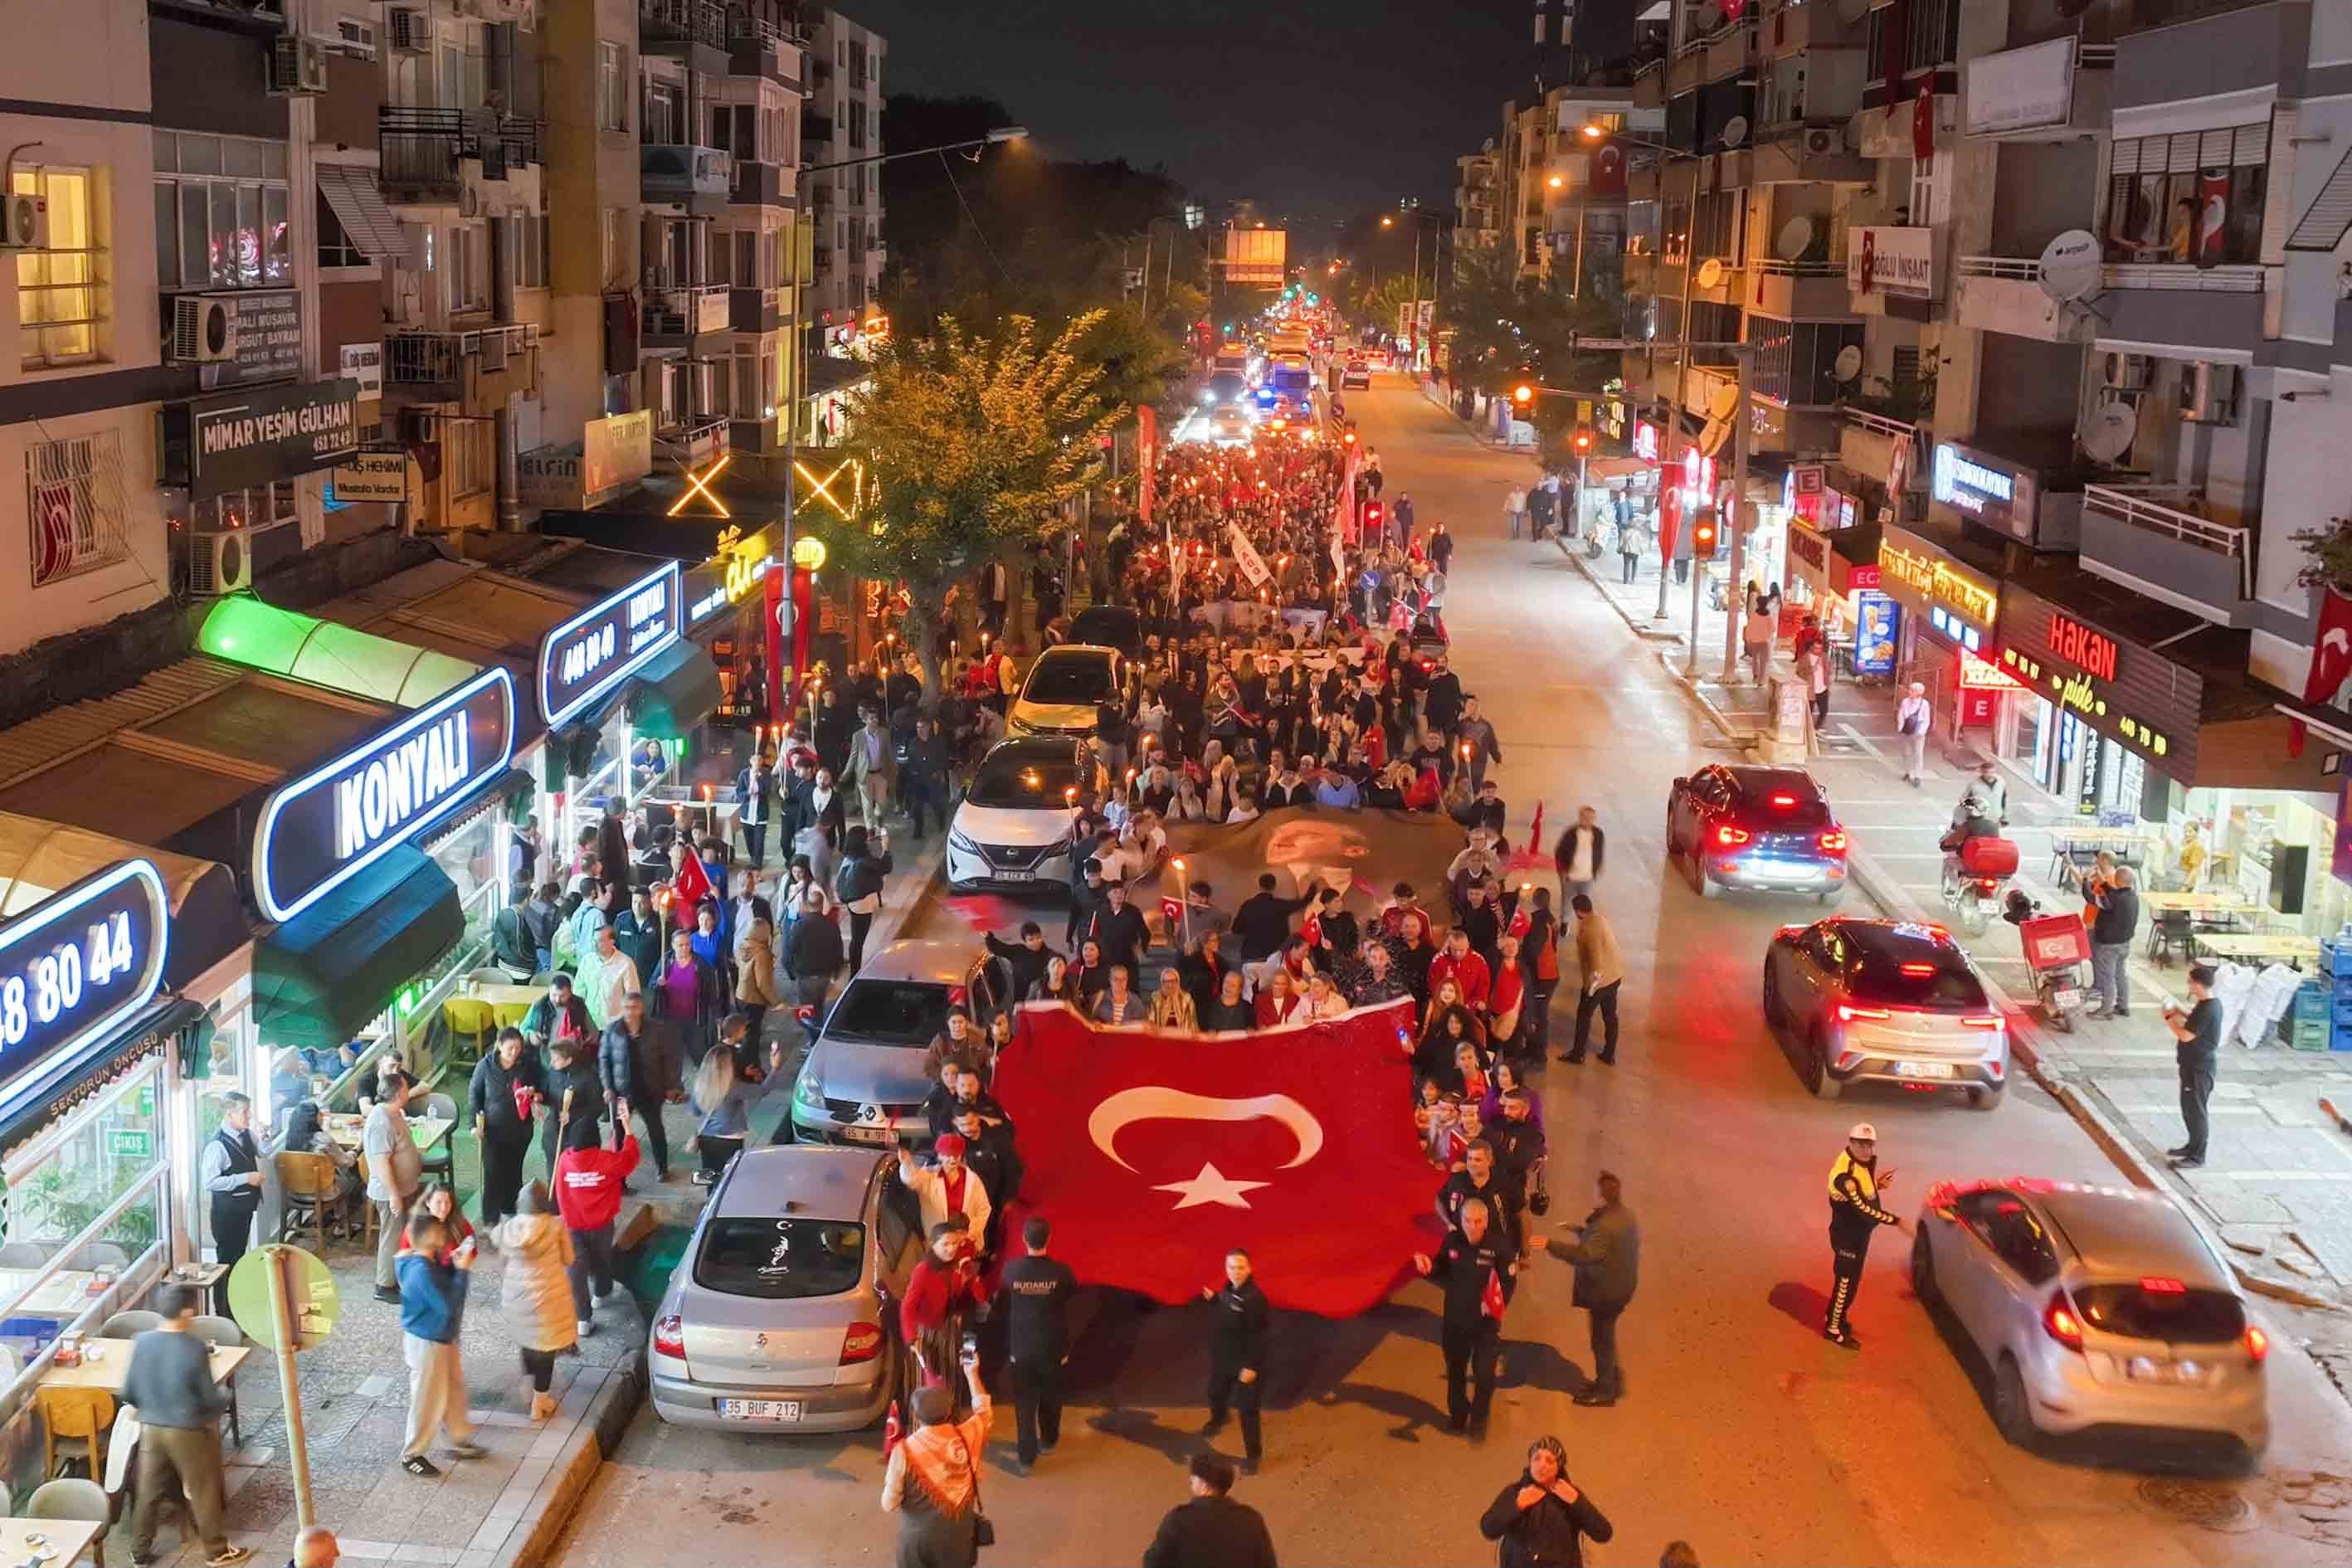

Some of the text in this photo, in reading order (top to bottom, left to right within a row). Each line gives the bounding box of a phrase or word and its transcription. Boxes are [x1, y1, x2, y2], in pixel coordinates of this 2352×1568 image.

[1898, 252, 1929, 285] İNŞAAT
[204, 400, 350, 455] MİMAR YEŞİM GÜLHAN
[338, 482, 372, 494] Mustafa
[335, 709, 469, 859] KONYALI
[37, 942, 82, 1023] 80
[89, 910, 134, 986] 44
[727, 1400, 797, 1417] 35 BUF 212
